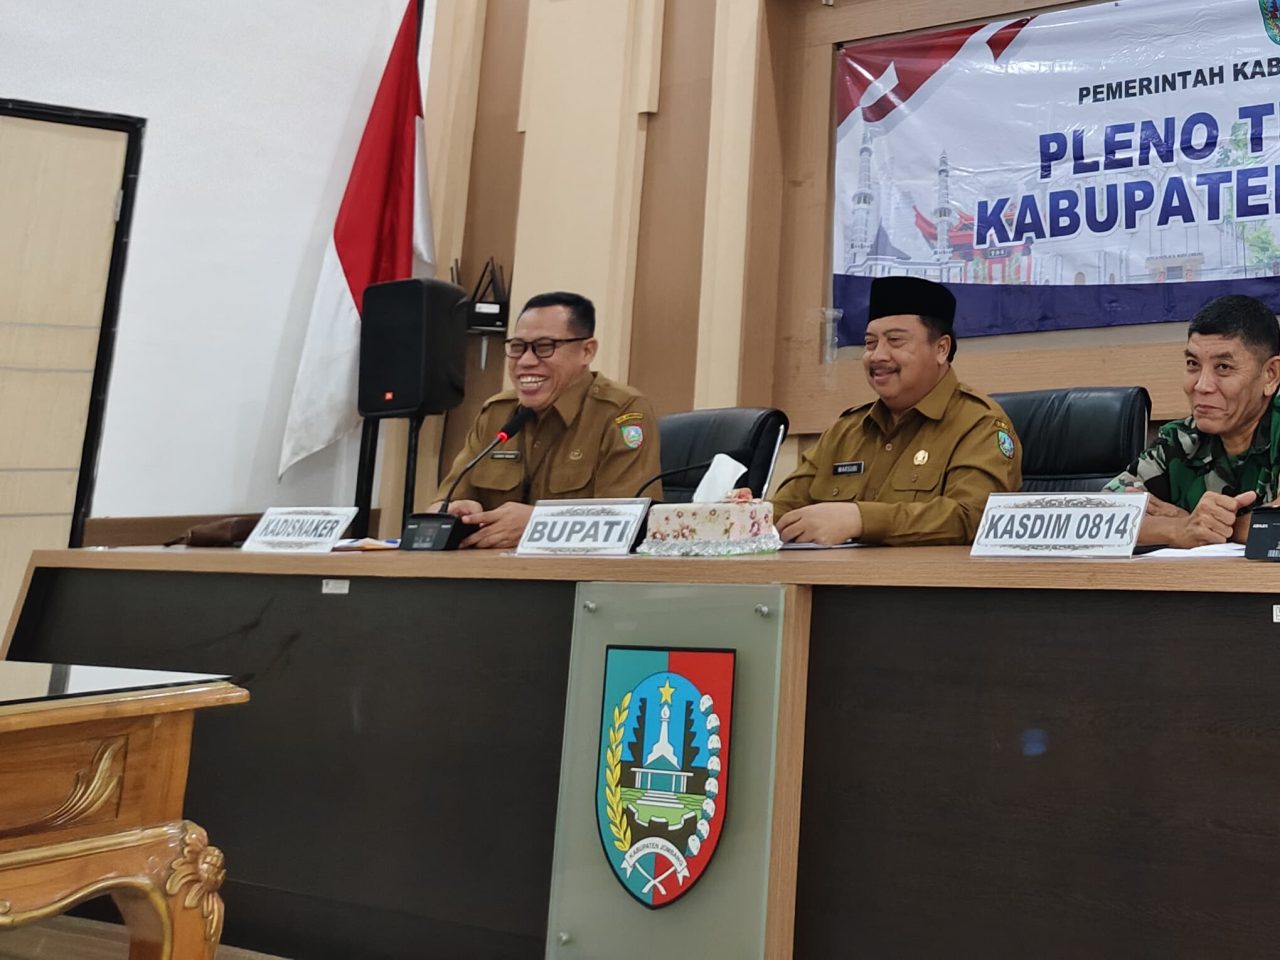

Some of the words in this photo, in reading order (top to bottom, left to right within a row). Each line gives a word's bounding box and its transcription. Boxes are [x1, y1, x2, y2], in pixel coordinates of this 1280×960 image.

[1078, 65, 1225, 105] PEMERINTAH
[1039, 111, 1220, 179] PLENO
[259, 519, 341, 538] KADISNAKER
[526, 520, 631, 543] BUPATI
[984, 513, 1073, 540] KASDIM
[1075, 512, 1131, 540] 0814
